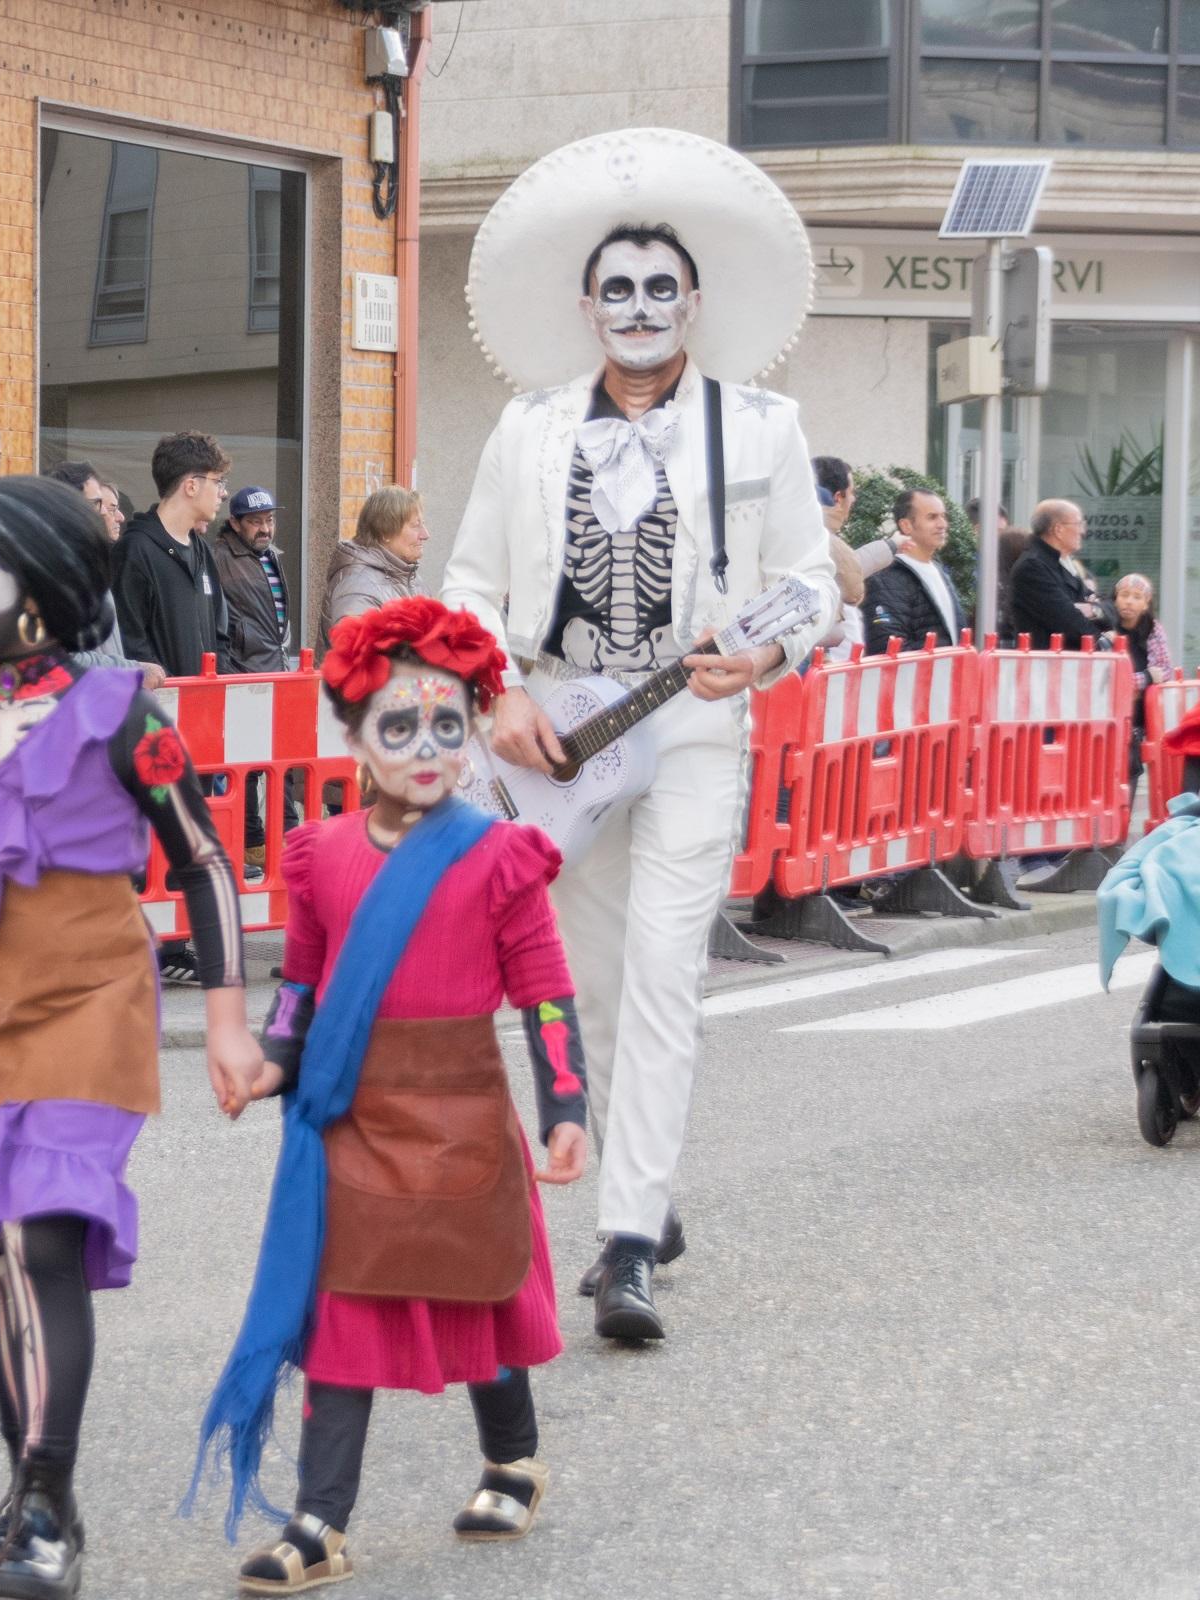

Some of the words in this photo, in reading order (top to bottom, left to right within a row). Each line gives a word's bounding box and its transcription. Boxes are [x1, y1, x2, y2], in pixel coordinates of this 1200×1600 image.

[884, 256, 1102, 293] XESTRVI
[1084, 514, 1129, 526] VIZOS
[1134, 514, 1144, 526] A
[1084, 529, 1137, 541] PRESAS
